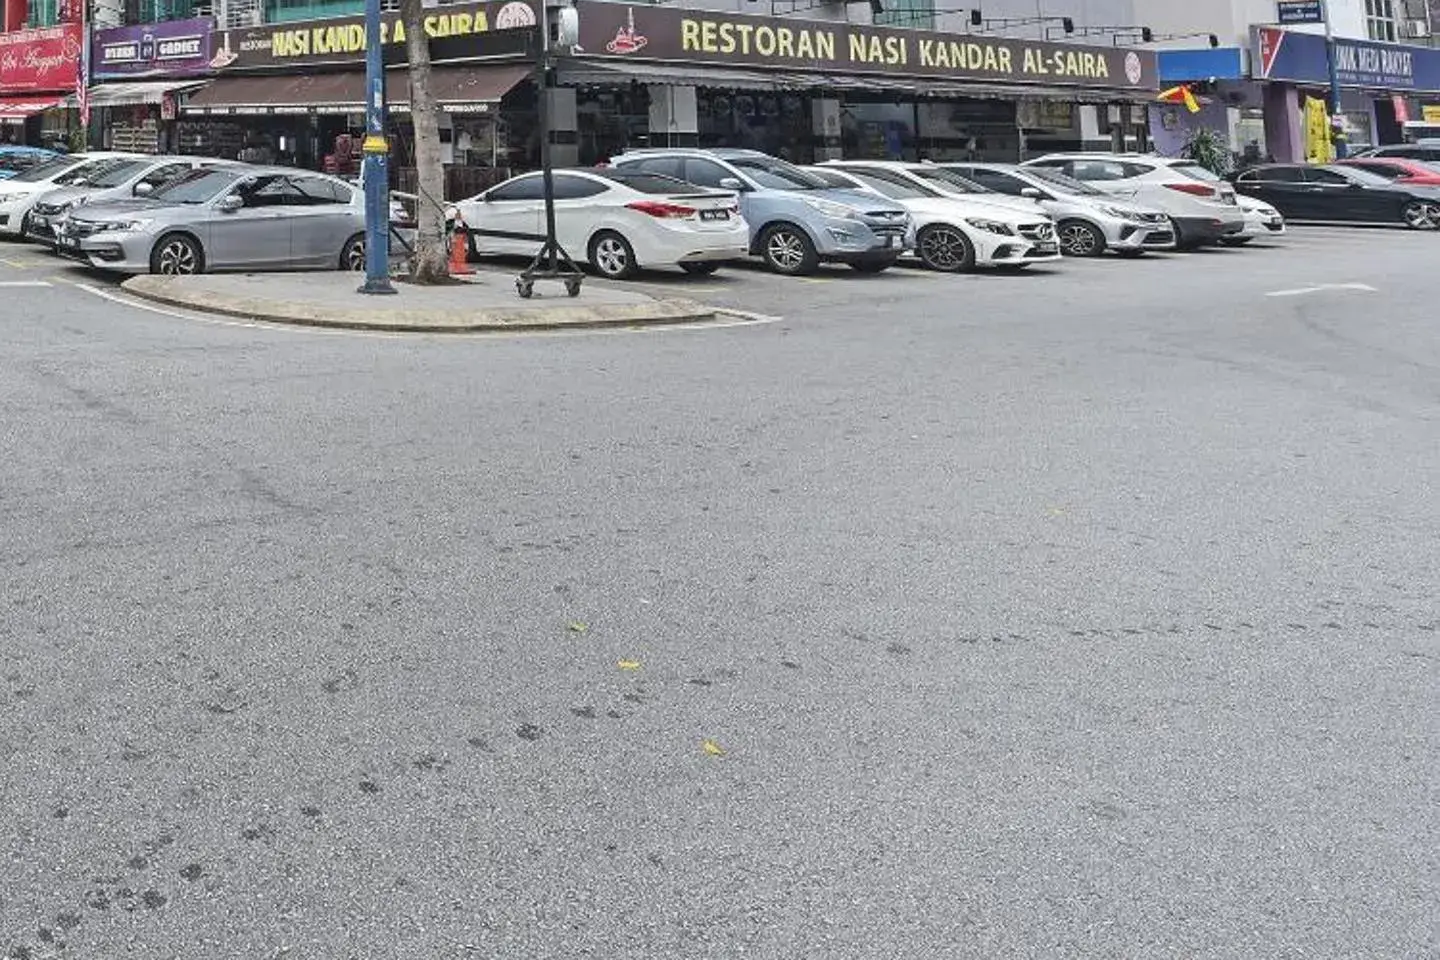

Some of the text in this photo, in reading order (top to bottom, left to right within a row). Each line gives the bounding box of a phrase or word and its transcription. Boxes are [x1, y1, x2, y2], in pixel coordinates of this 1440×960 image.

[271, 27, 310, 57] NASI
[312, 22, 389, 55] KANDR
[681, 18, 1109, 78] RESTORAN NASI KANDAR AL-SAIRA
